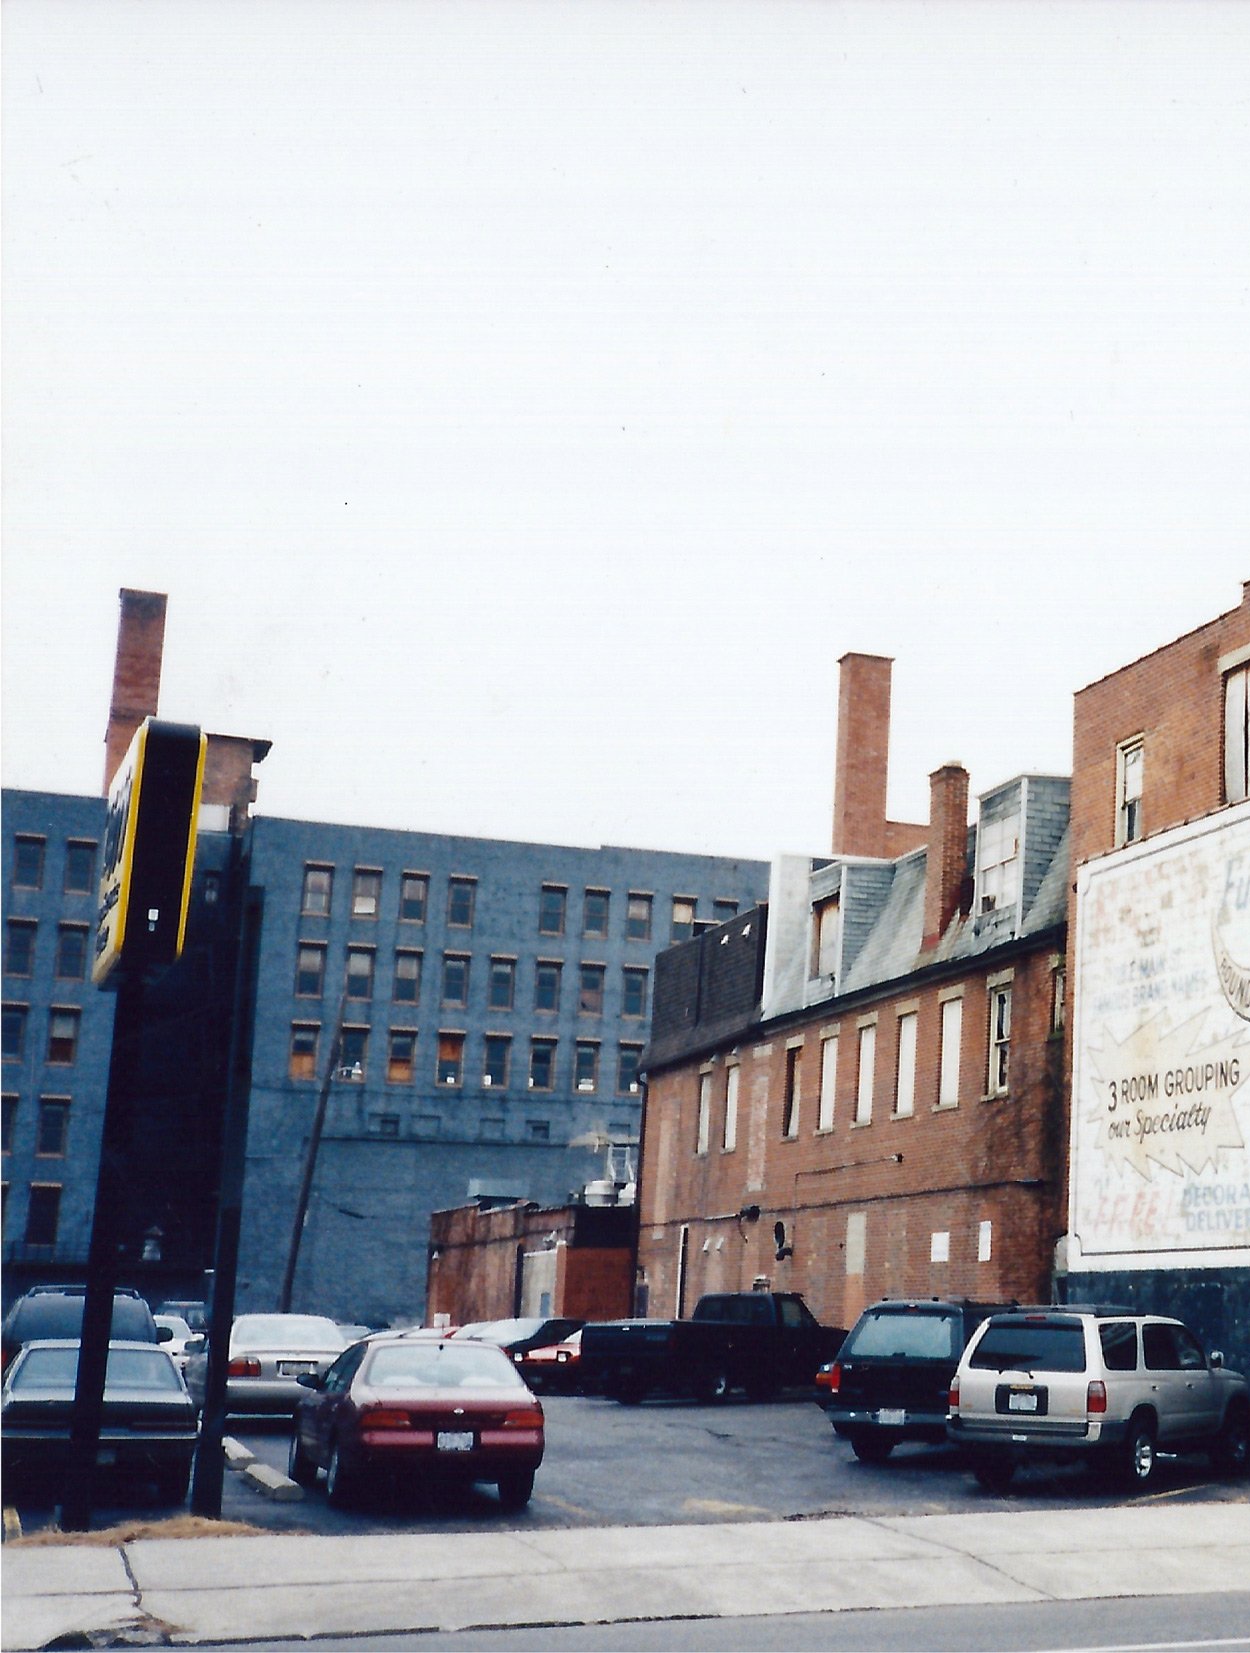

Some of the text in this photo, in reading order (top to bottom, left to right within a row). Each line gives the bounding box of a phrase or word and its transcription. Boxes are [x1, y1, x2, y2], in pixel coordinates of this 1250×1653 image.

[1107, 1058, 1240, 1112] 3 ROOM GROUPING
[1134, 1102, 1211, 1144] Specialty
